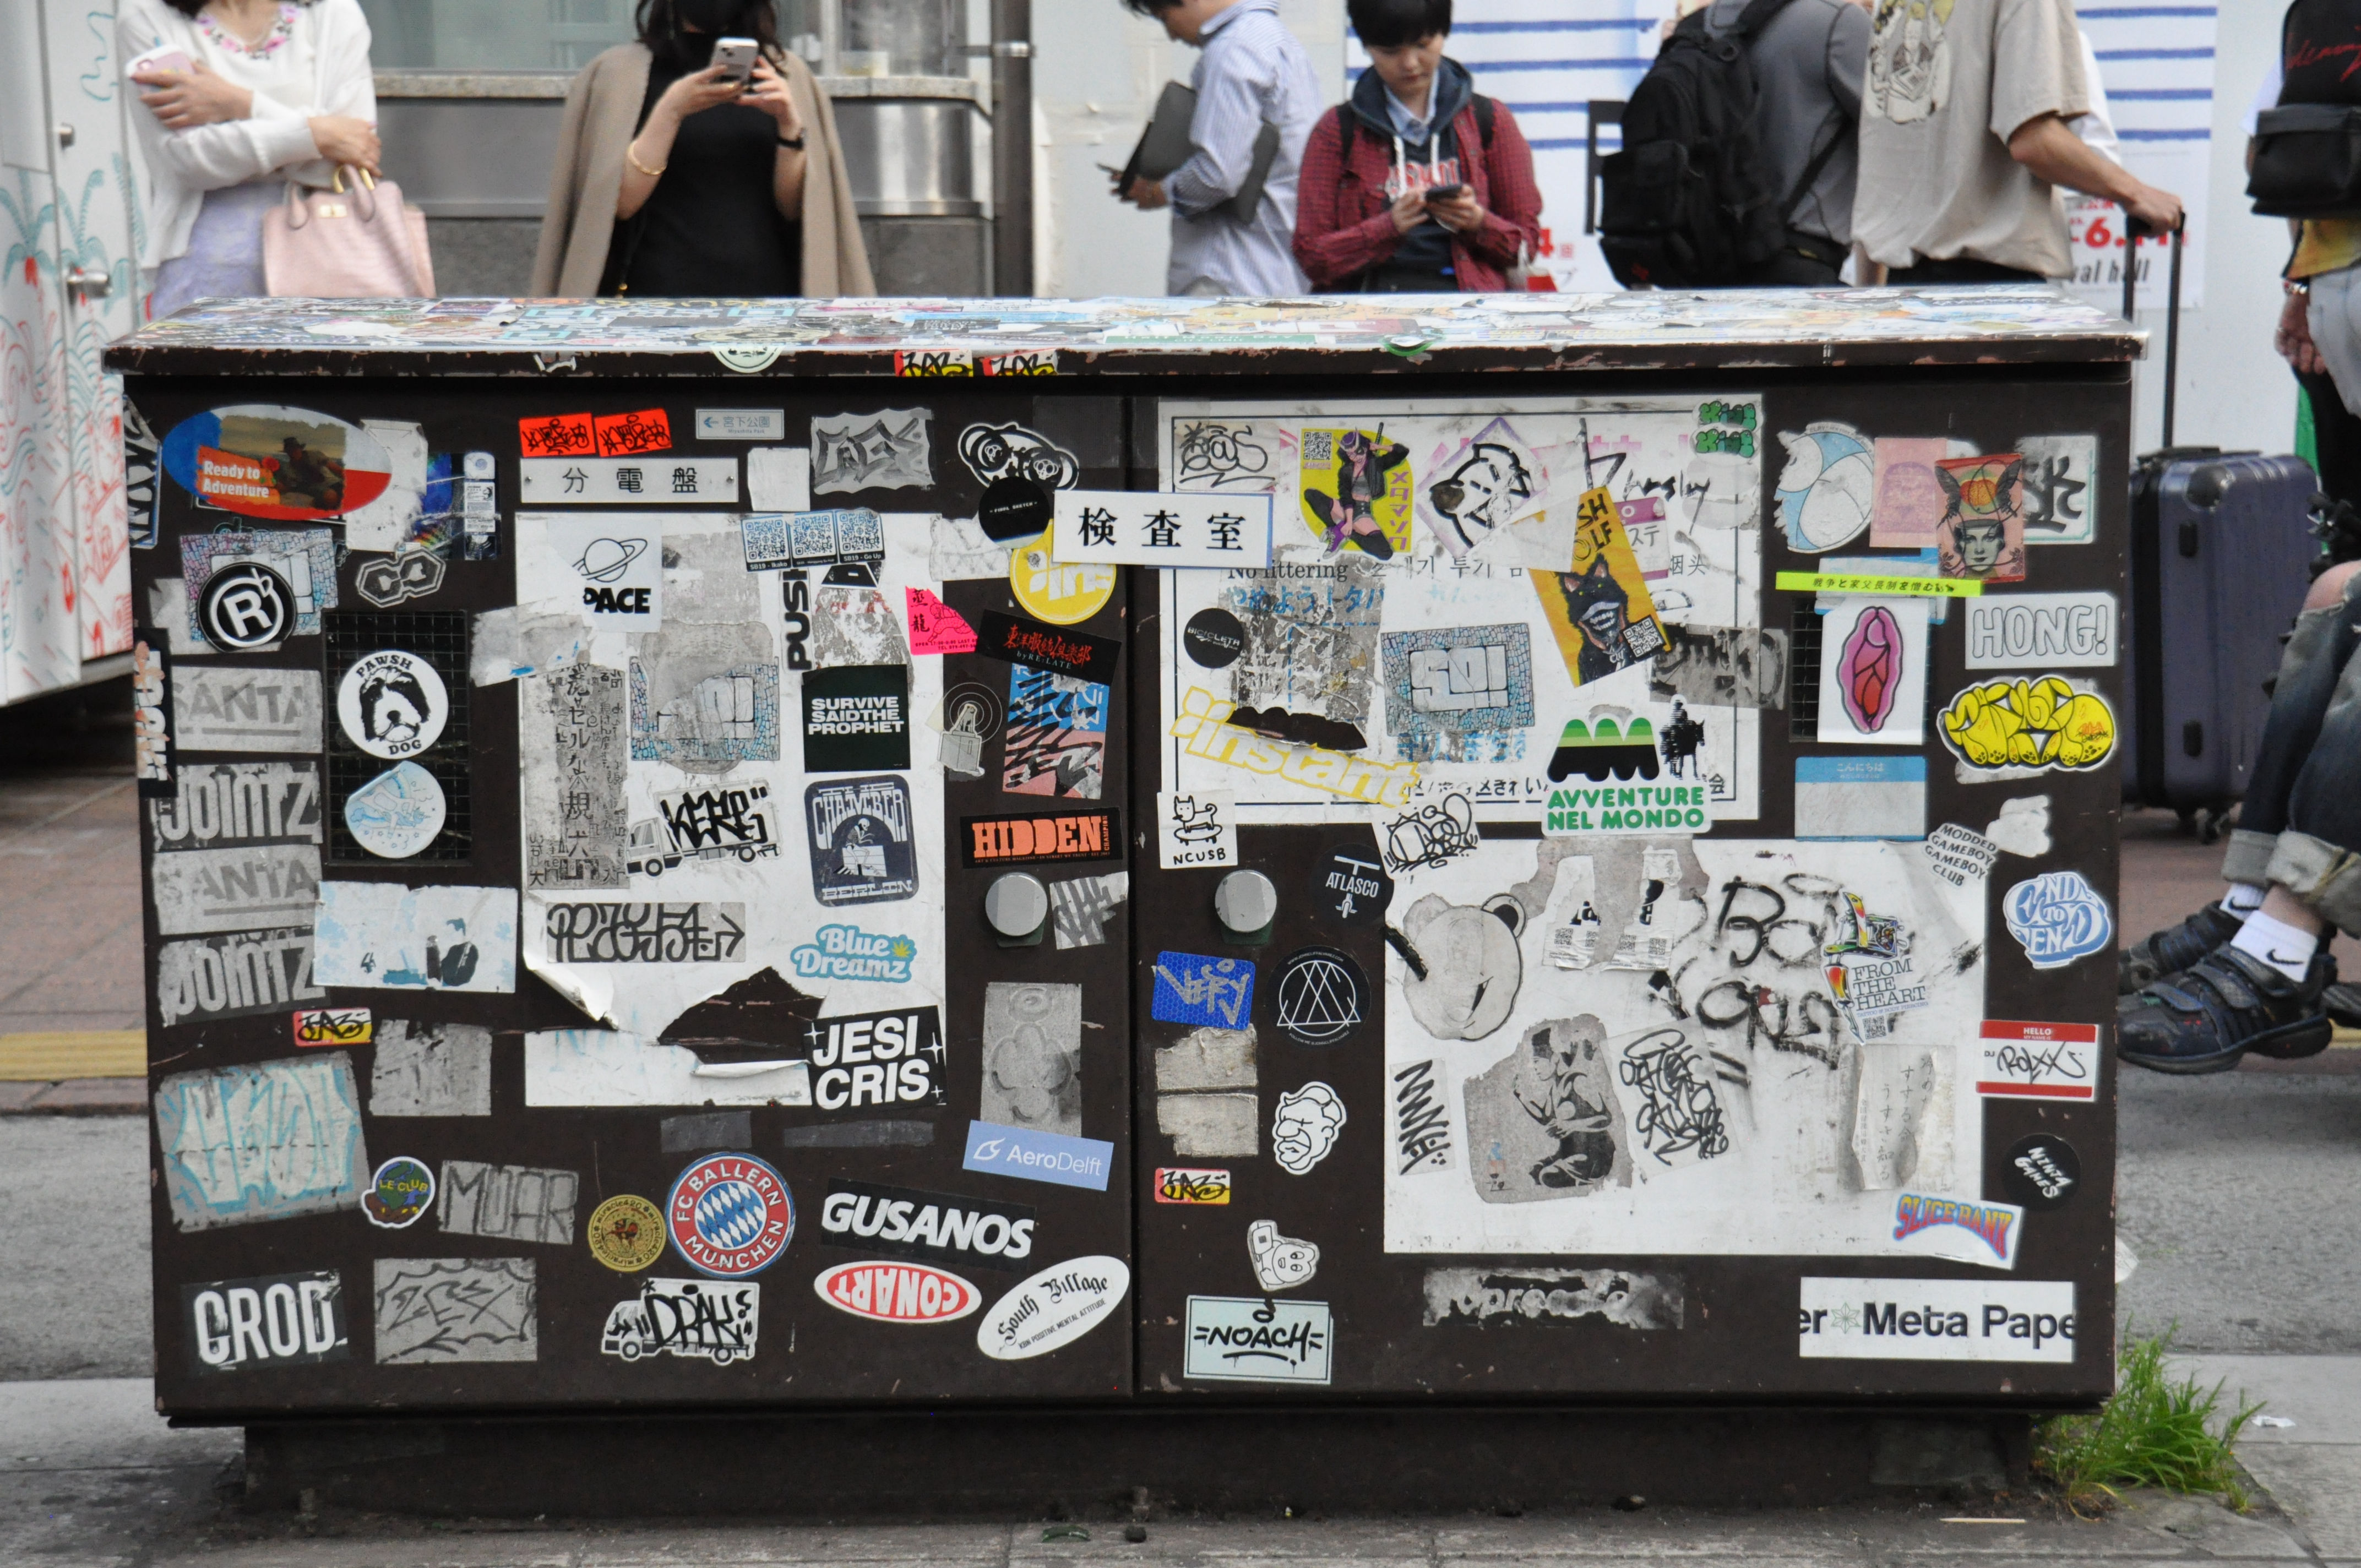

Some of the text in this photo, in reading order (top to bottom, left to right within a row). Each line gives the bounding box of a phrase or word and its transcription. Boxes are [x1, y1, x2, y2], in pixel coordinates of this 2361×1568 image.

[203, 461, 260, 480] Ready to
[562, 466, 699, 495] 分電盤
[203, 479, 270, 499] Adventure
[1077, 507, 1248, 551] 検査室
[1972, 603, 2108, 659] HONG!
[356, 654, 414, 678] PAWSH
[811, 696, 899, 711] SURVIVE
[808, 721, 905, 736] PROPHET
[388, 738, 423, 756] DOG
[1547, 786, 1704, 810] AVVENTURE
[1548, 809, 1704, 830] NEL MONDO
[972, 815, 1102, 858] HIDDEN
[1930, 834, 1994, 866] GAMEBOY
[1940, 824, 1997, 853] MODDED
[1173, 848, 1227, 865] NCUSB
[1924, 845, 1987, 880] GAMEBOY
[1325, 870, 1379, 899] ATLASCO
[1932, 862, 1965, 887] CLUB
[819, 926, 890, 957] Blue
[795, 949, 909, 979] Dreamz
[1852, 957, 1913, 982] FROM
[1852, 976, 1896, 997] THE
[1854, 986, 1926, 1011] HEART
[813, 1015, 918, 1067] JESI
[2023, 1027, 2053, 1036] HELLO
[815, 1058, 931, 1110] CRIS
[1007, 1144, 1102, 1177] AeroDelft
[2028, 1146, 2073, 1187] NINJA
[379, 1179, 429, 1193] LE CLUB
[677, 1162, 783, 1222] FC BALLERN
[2014, 1157, 2059, 1199] GAMES
[822, 1192, 1035, 1259] GUSANOS
[1894, 1193, 2014, 1260] SLICE BANK
[685, 1219, 785, 1269] MUNCHEN
[834, 1266, 960, 1317] CONART
[997, 1271, 1109, 1347] South Village
[1031, 1325, 1057, 1345] POSITIVE
[1057, 1313, 1079, 1332] MENTAL
[1078, 1298, 1107, 1321] ATTITUDE
[1207, 1321, 1312, 1362] NOACH
[1863, 1302, 1968, 1336] Meta
[1982, 1304, 2075, 1350] Pape
